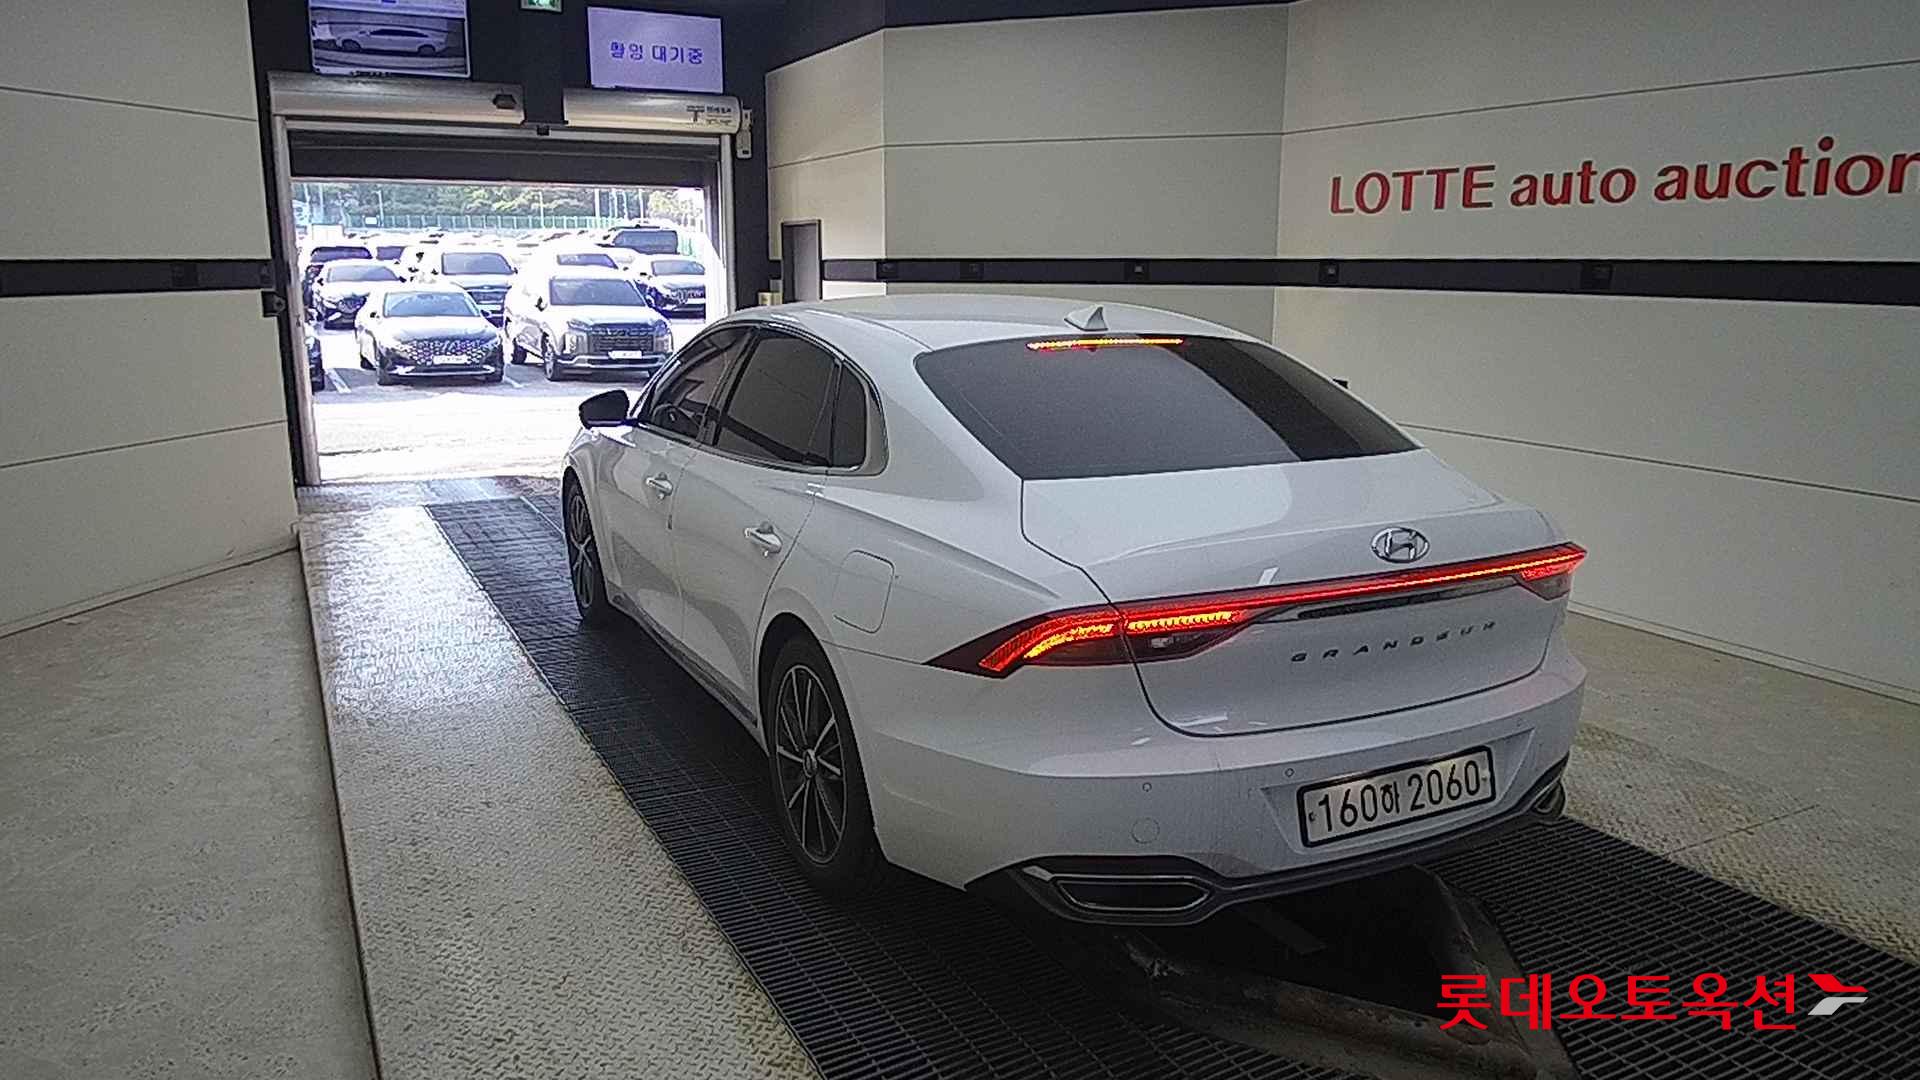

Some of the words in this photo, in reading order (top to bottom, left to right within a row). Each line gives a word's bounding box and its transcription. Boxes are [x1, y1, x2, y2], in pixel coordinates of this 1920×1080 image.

[652, 45, 703, 65] 대기중
[1330, 164, 1496, 215] LOTTE
[1511, 161, 1637, 206] auto
[1290, 620, 1496, 663] GRANDEUR
[1317, 781, 1400, 832] 160하
[1407, 760, 1481, 812] 2060
